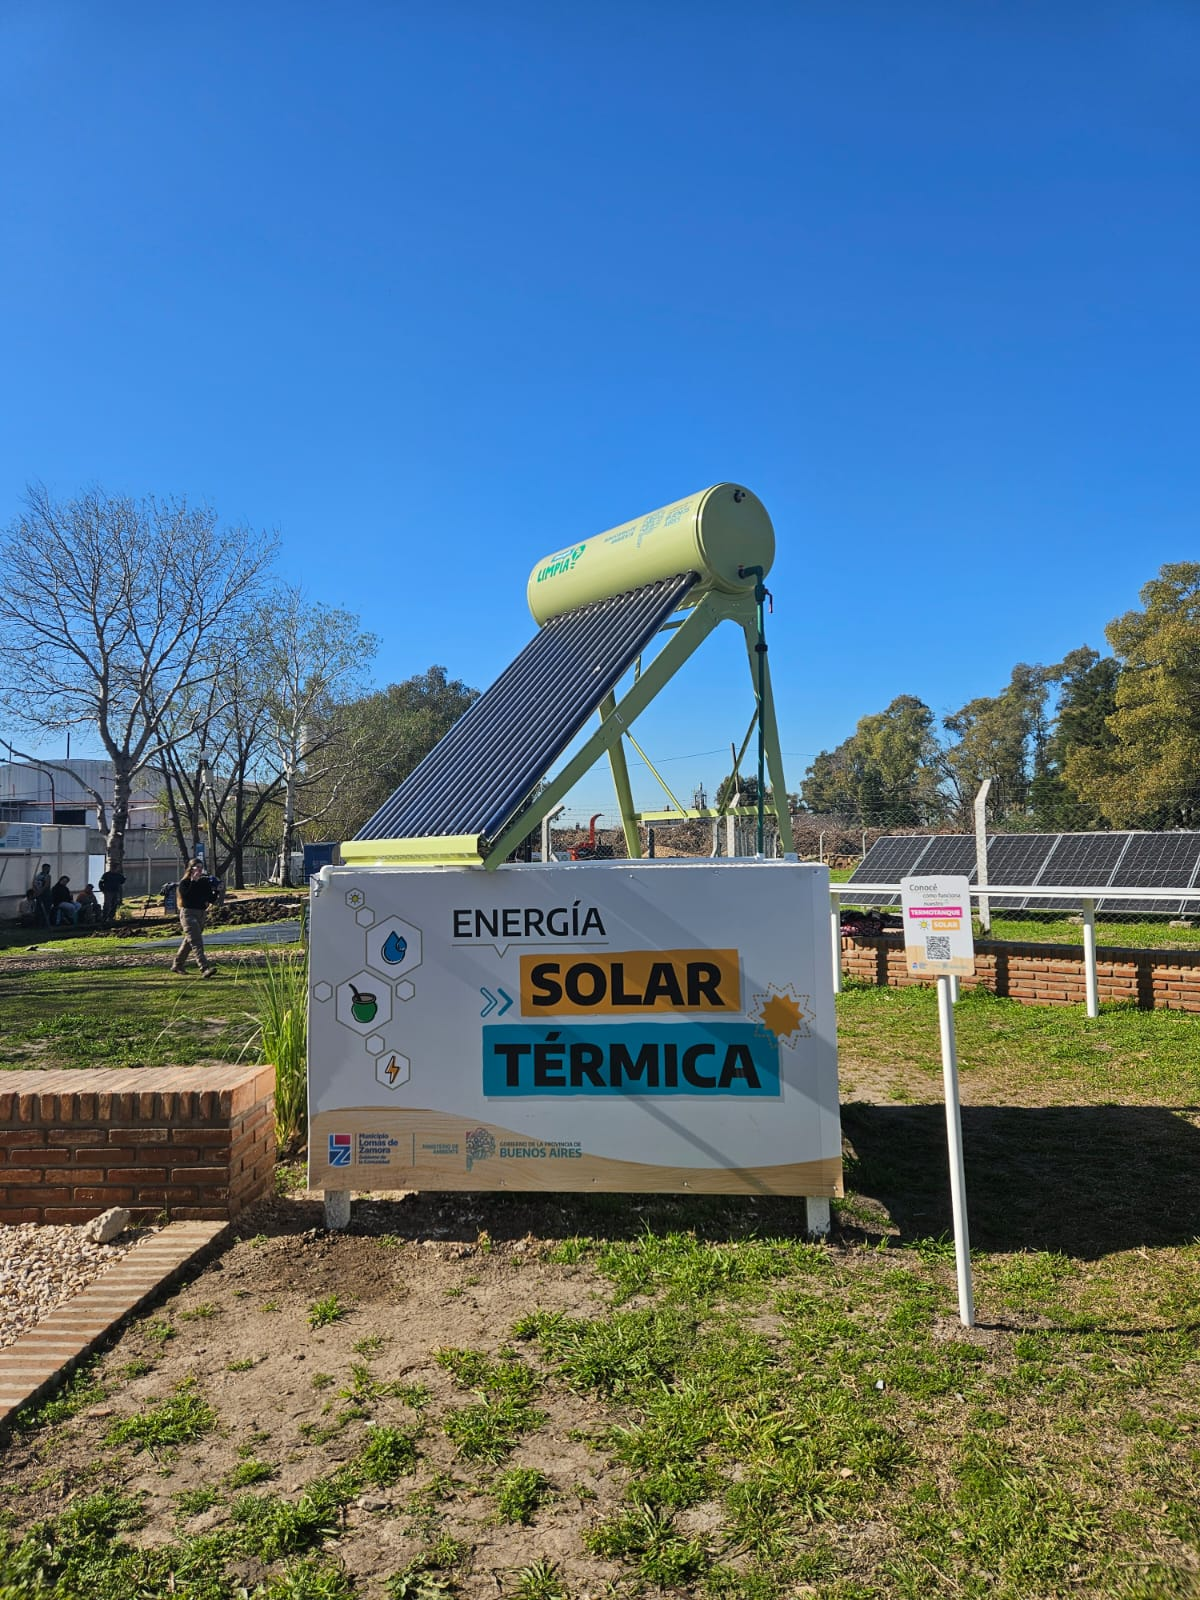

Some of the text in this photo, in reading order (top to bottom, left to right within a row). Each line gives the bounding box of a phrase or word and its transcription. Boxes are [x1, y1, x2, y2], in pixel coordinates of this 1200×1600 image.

[909, 883, 938, 891] Conocé
[453, 901, 606, 938] ENERGÍA
[530, 962, 726, 1007] SOLAR
[494, 1032, 761, 1089] TÉRMICA
[387, 1138, 399, 1146] de
[499, 1147, 582, 1158] BUENOS AIRES
